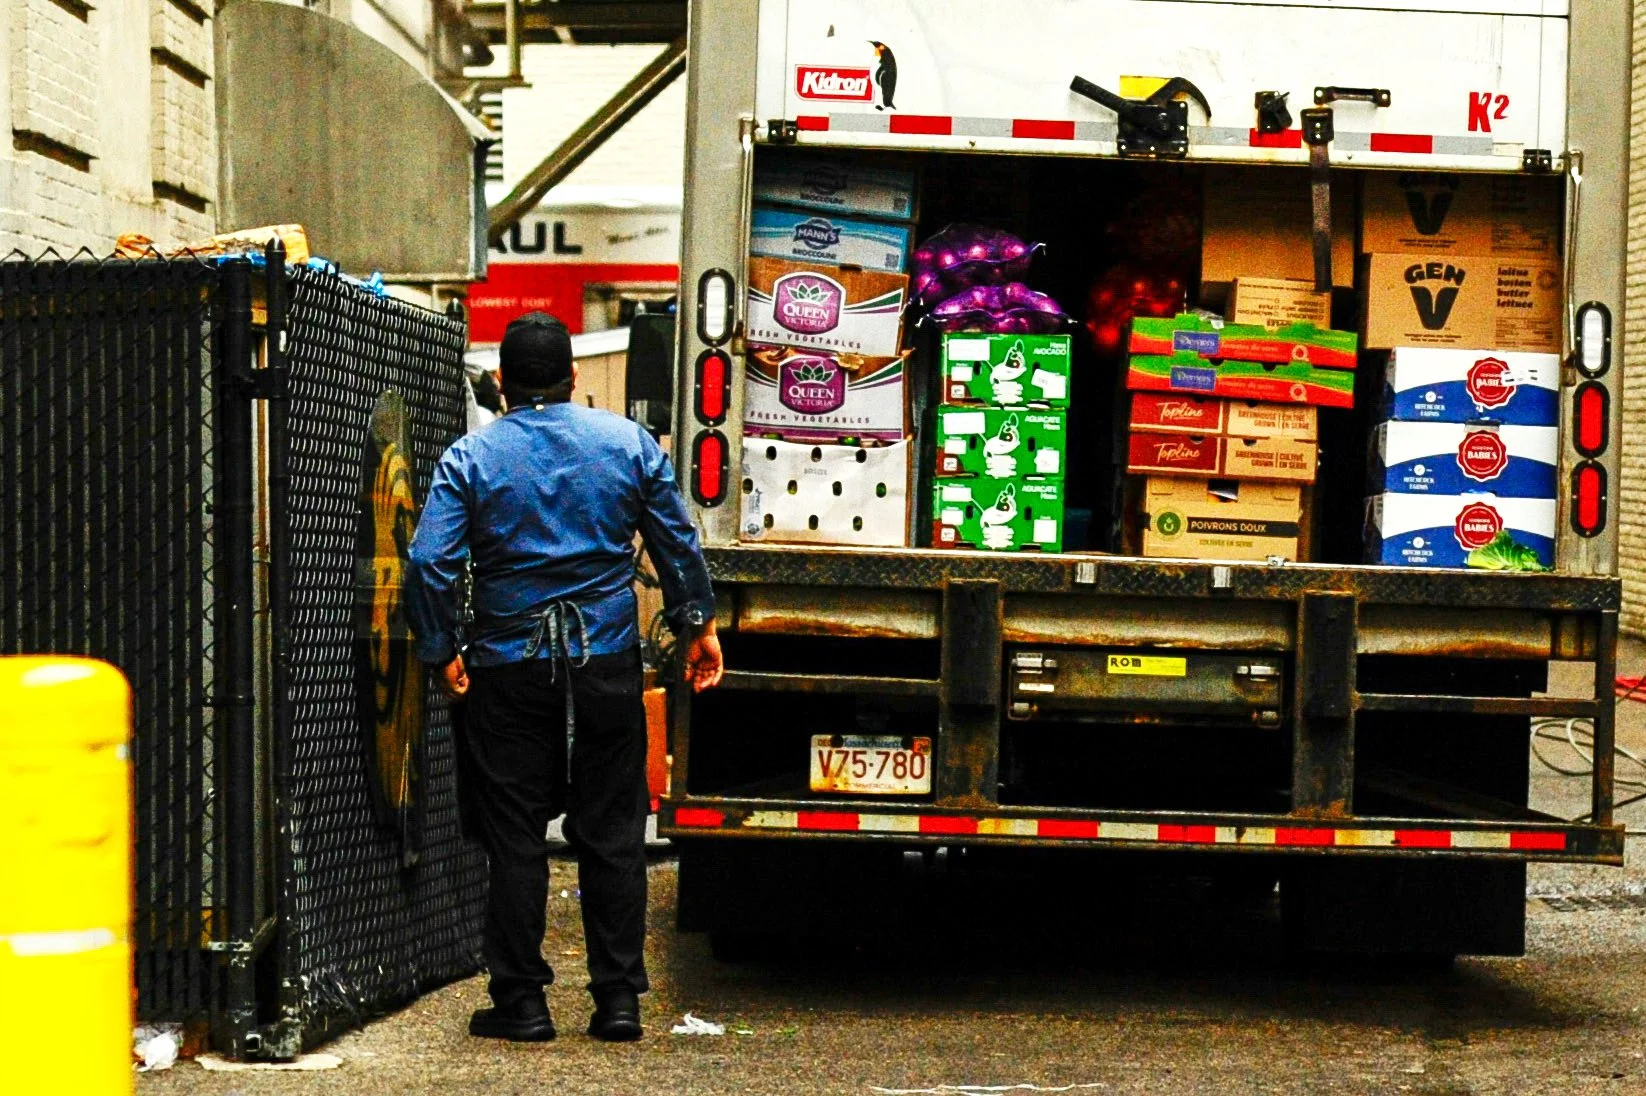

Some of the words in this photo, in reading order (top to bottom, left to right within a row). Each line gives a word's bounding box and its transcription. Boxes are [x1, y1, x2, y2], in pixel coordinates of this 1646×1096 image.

[801, 71, 868, 95] Kidron
[1404, 262, 1466, 286] GEN
[1497, 288, 1530, 297] butter
[1410, 286, 1460, 331] V
[1497, 299, 1534, 308] lettuce
[783, 303, 830, 319] QUEEN
[784, 316, 829, 329] VICTORIA
[750, 329, 779, 339] RESH
[787, 334, 861, 349] VEGETABLES
[1032, 348, 1067, 356] AVOCADO
[788, 385, 834, 399] QUEEN
[791, 398, 834, 407] VICTORIA
[750, 411, 786, 420] FRESH
[794, 415, 870, 424] VEGETABLES
[1157, 402, 1204, 421] Topline
[1154, 443, 1200, 462] Topline
[1191, 521, 1238, 532] POIVRONS
[1240, 523, 1267, 533] DOUX
